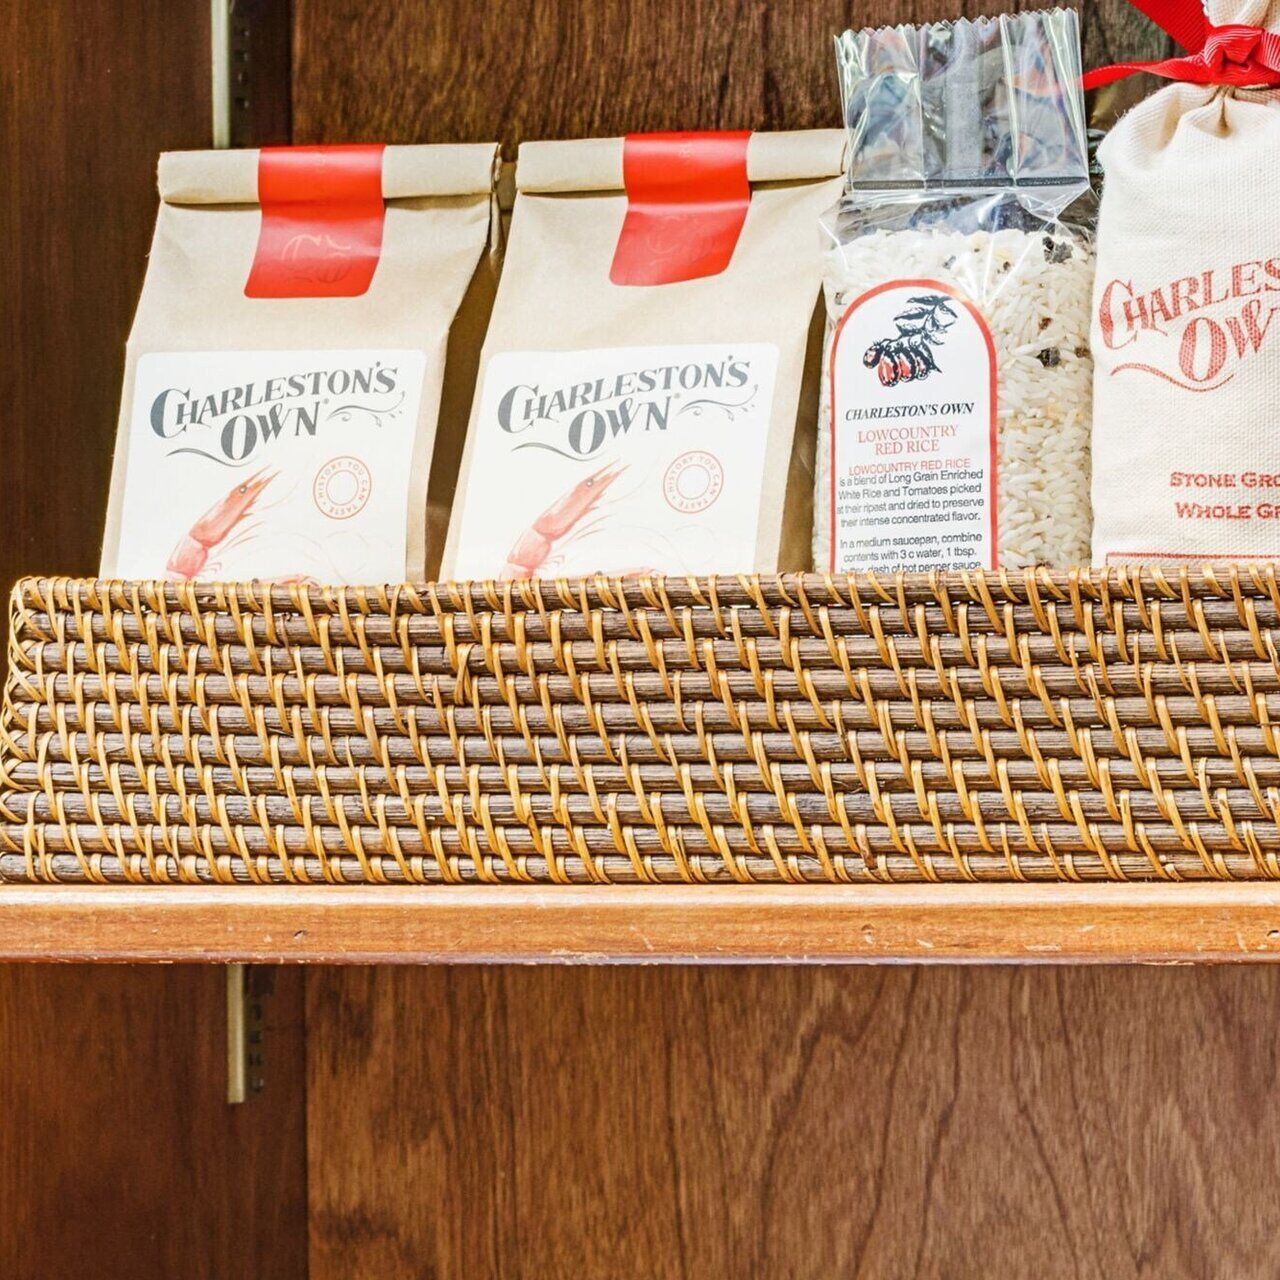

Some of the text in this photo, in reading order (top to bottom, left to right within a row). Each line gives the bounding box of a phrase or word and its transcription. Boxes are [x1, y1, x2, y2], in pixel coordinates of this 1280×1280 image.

[150, 361, 398, 438] CHARLESTON'S
[498, 355, 751, 433] CHARLESTON'S
[845, 403, 974, 421] CHARLESTON'S OWN
[221, 401, 320, 460] OWN
[568, 396, 671, 454] OWN
[858, 424, 959, 443] LOWCOUNTRY
[875, 439, 940, 455] RED RICE
[849, 458, 970, 476] LOWCOUNTRY RED RICE
[888, 473, 911, 484] Long
[913, 470, 938, 482] Grain
[941, 469, 983, 481] Enriched
[1170, 472, 1236, 488] STONE
[883, 486, 900, 497] and
[902, 485, 948, 497] Tomatoes
[950, 483, 981, 496] picked
[888, 498, 984, 511] and dried to preserve
[1175, 502, 1252, 520] WHOLE
[891, 512, 950, 524] concentrated
[952, 511, 981, 521] flavor.
[941, 532, 982, 543] combine
